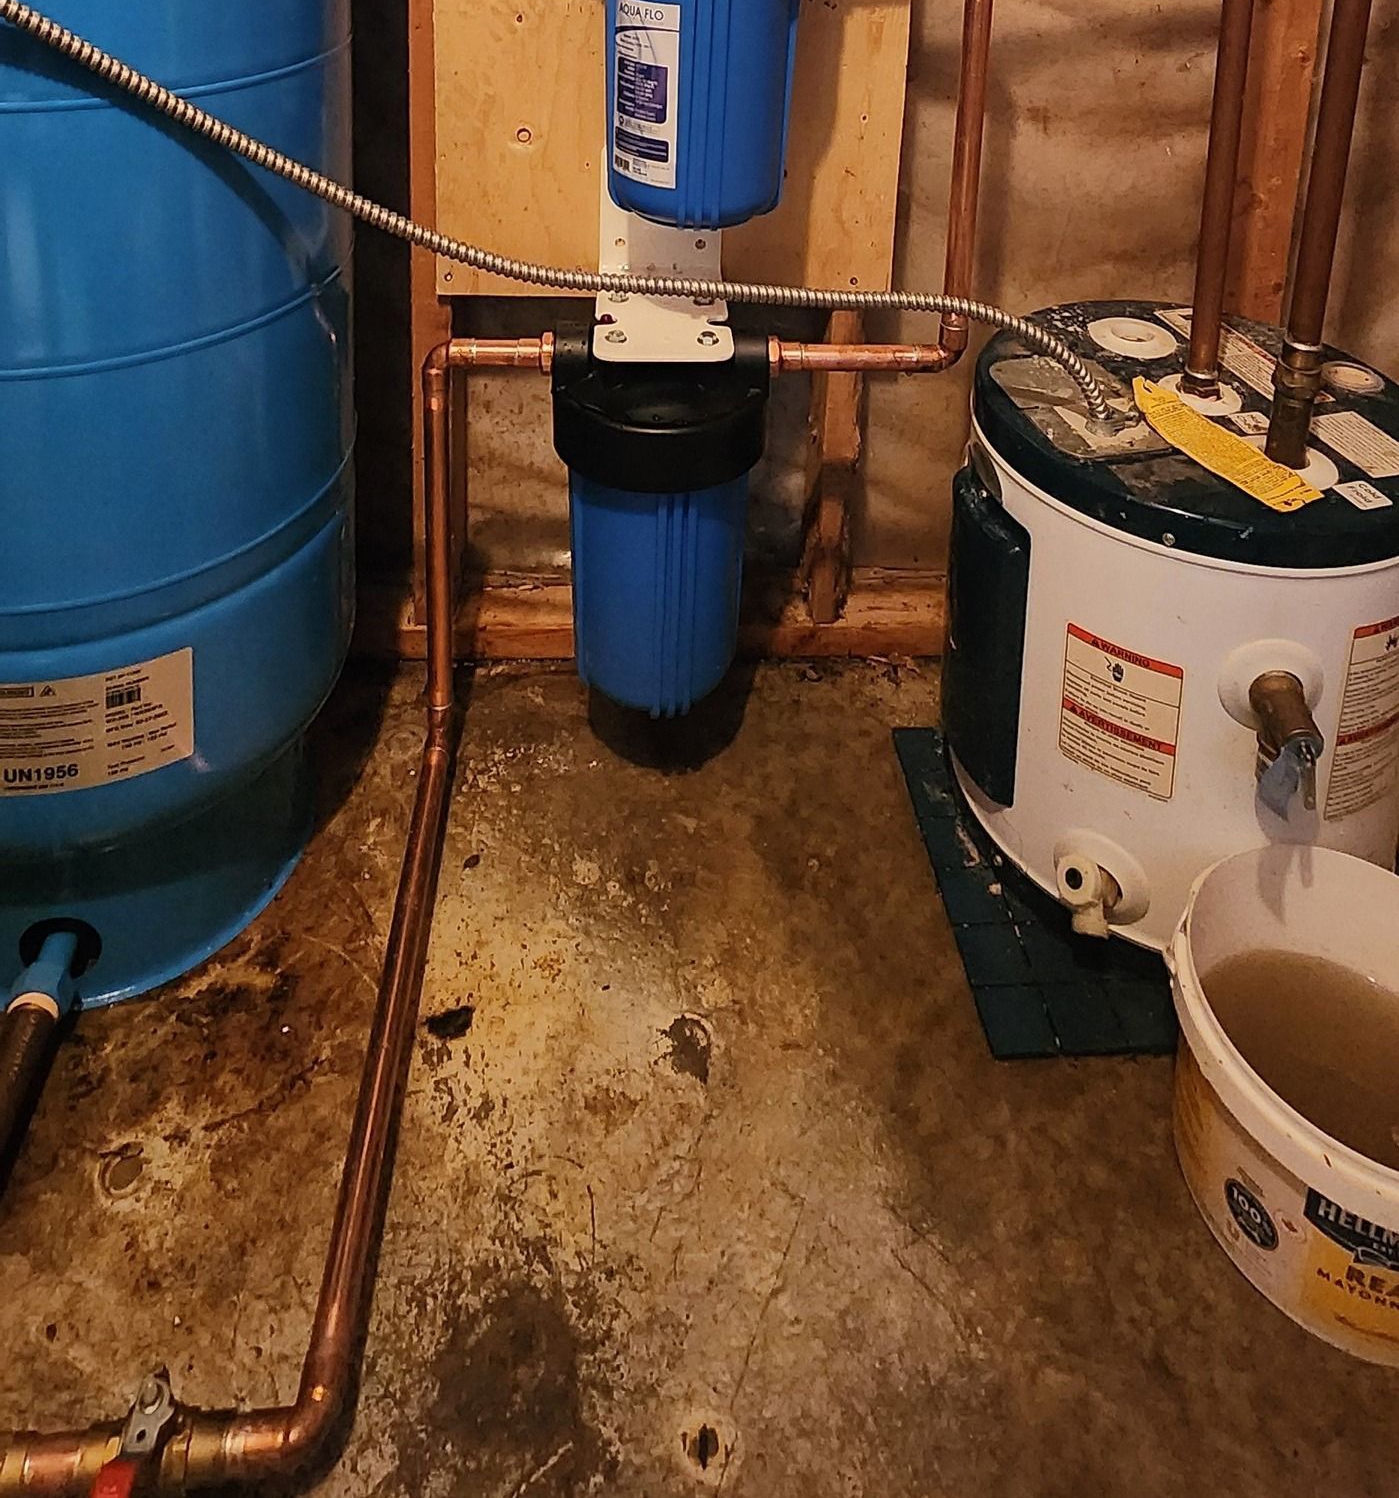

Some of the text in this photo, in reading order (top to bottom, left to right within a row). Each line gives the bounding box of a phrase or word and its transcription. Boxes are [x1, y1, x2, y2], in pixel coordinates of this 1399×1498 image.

[619, 2, 664, 21] AQUA FLO
[1359, 483, 1382, 499] Cold
[1100, 642, 1150, 668] WARNING
[3, 763, 79, 783] UN1956
